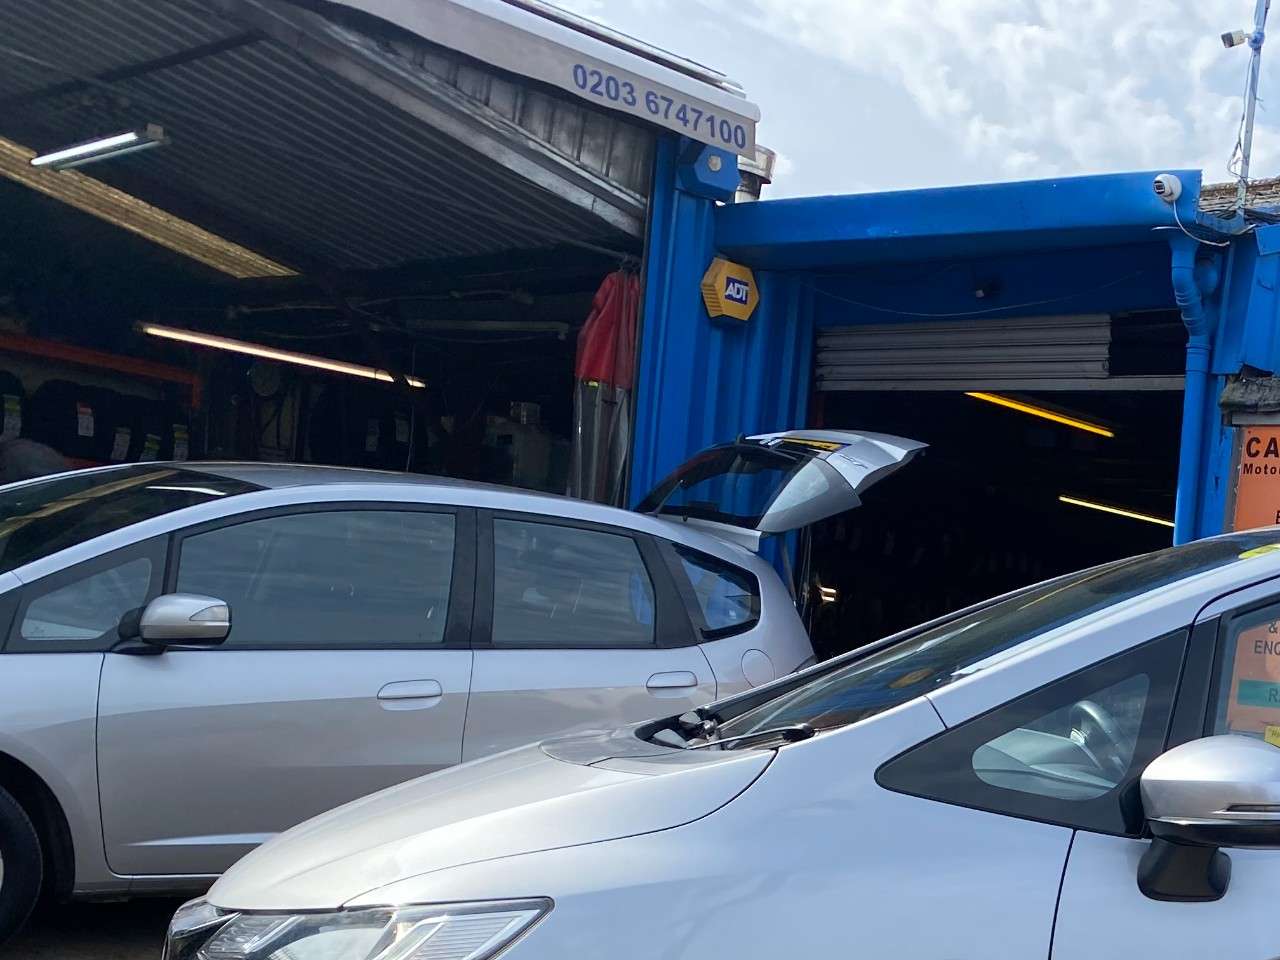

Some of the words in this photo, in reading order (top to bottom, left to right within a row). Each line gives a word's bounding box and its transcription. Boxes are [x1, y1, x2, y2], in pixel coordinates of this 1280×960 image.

[573, 64, 637, 107] 0203
[645, 90, 746, 149] 6747100
[725, 282, 749, 301] ADT
[1268, 620, 1278, 634] &
